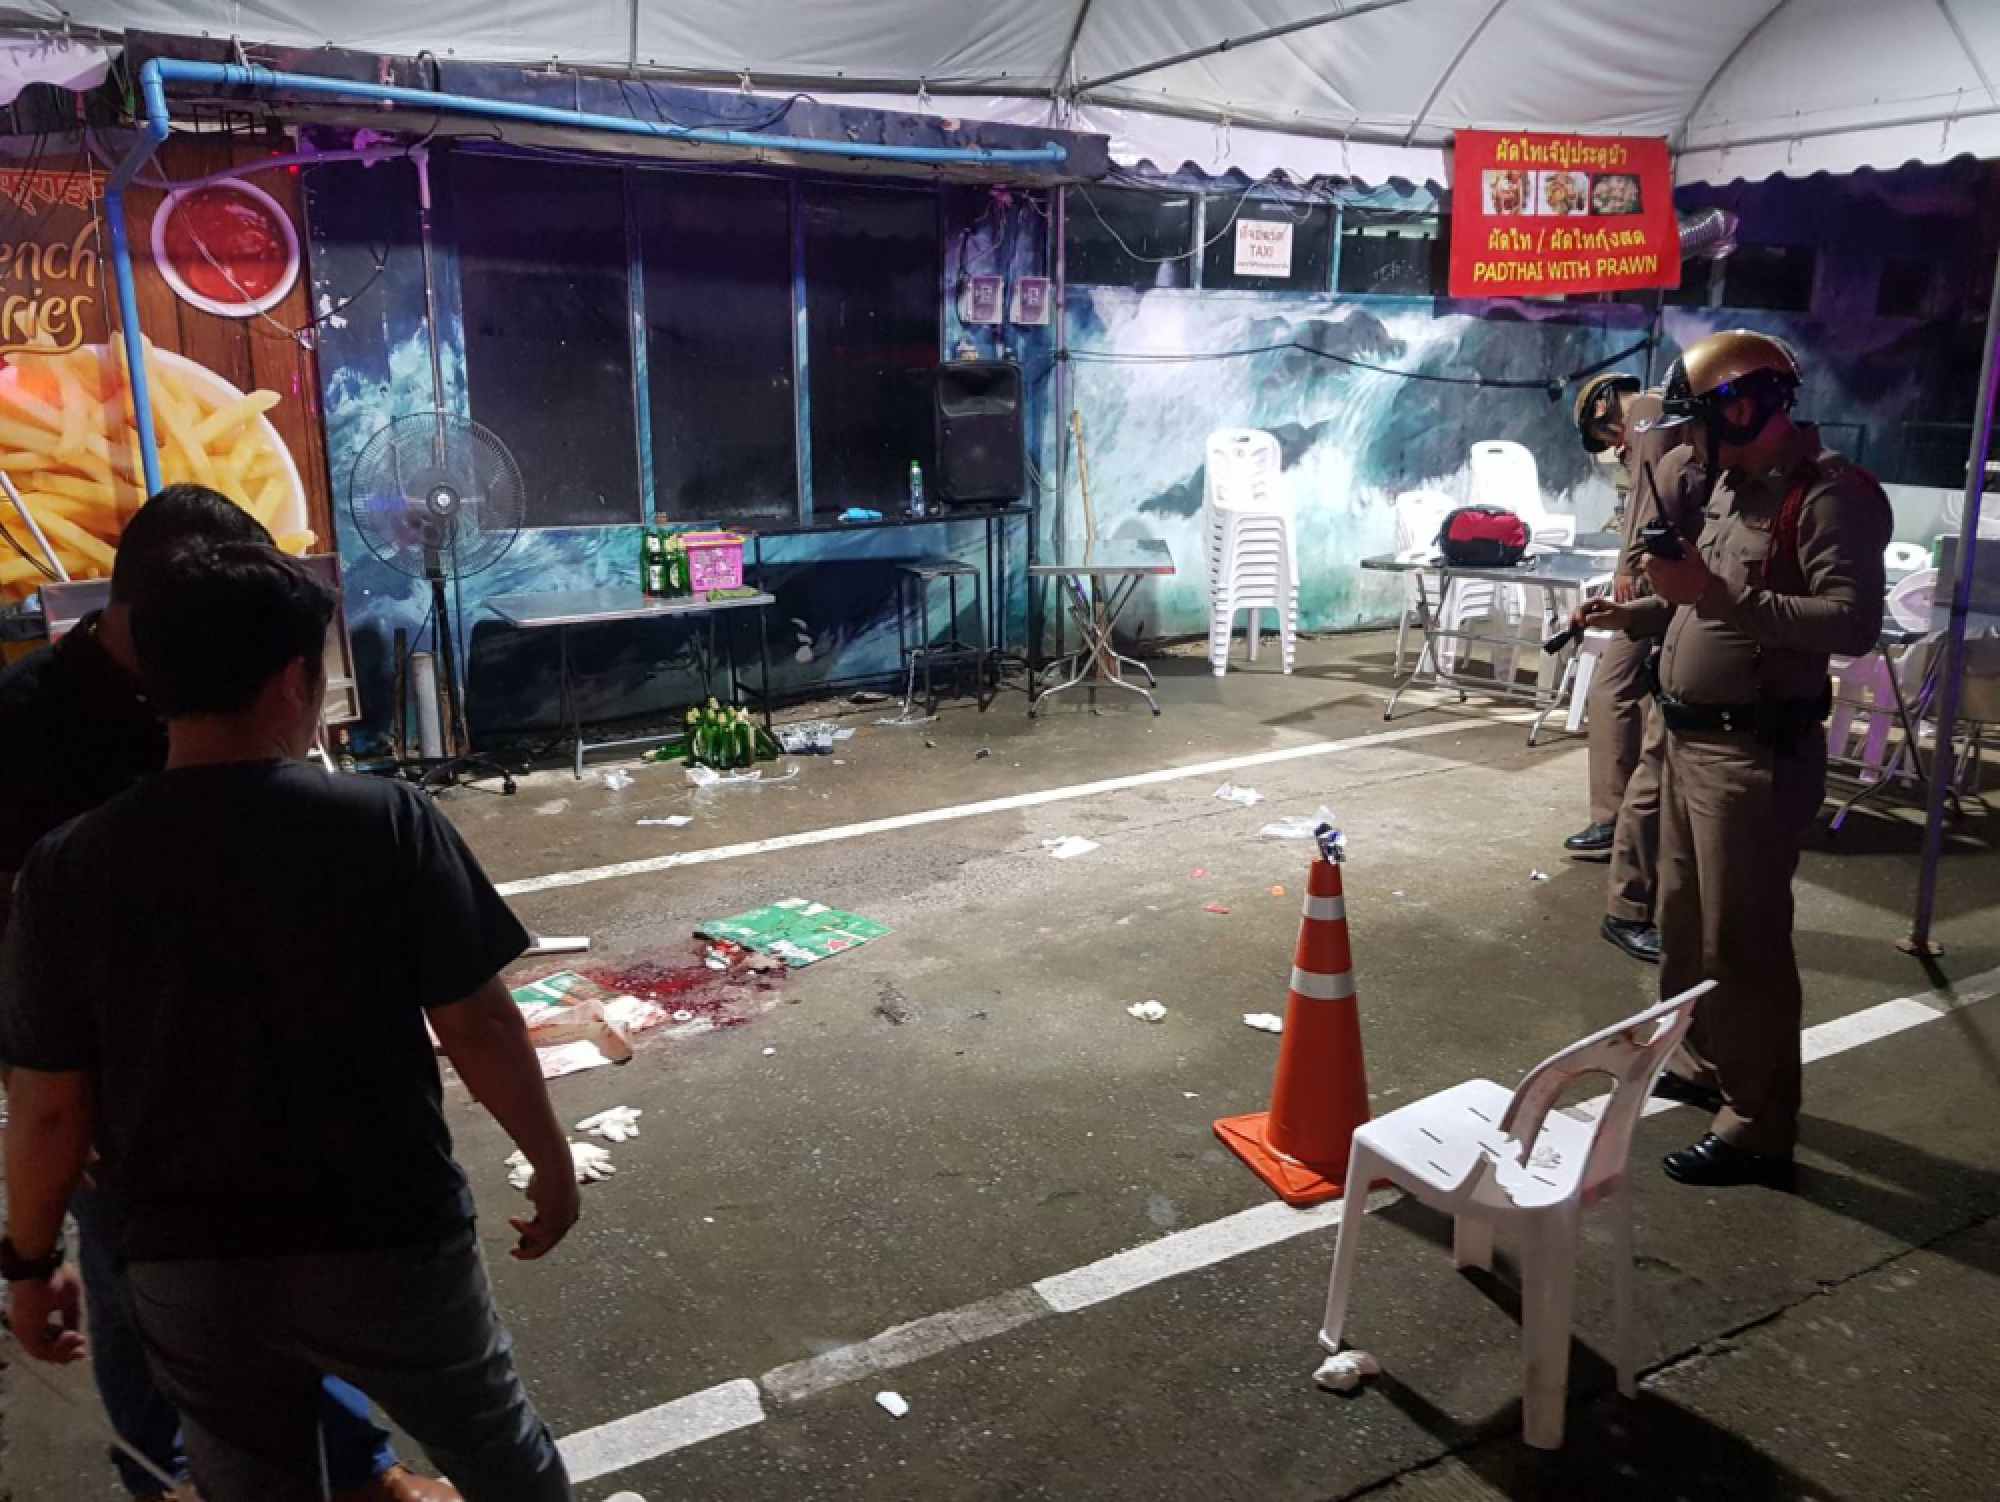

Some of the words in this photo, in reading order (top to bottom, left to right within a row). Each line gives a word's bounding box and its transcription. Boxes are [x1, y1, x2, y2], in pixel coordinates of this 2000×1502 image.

[1249, 244, 1275, 258] TAXI
[1474, 262, 1544, 282] PADTHAI
[1550, 261, 1590, 281] WITH
[1597, 255, 1658, 277] PRAWN
[0, 287, 93, 353] ries
